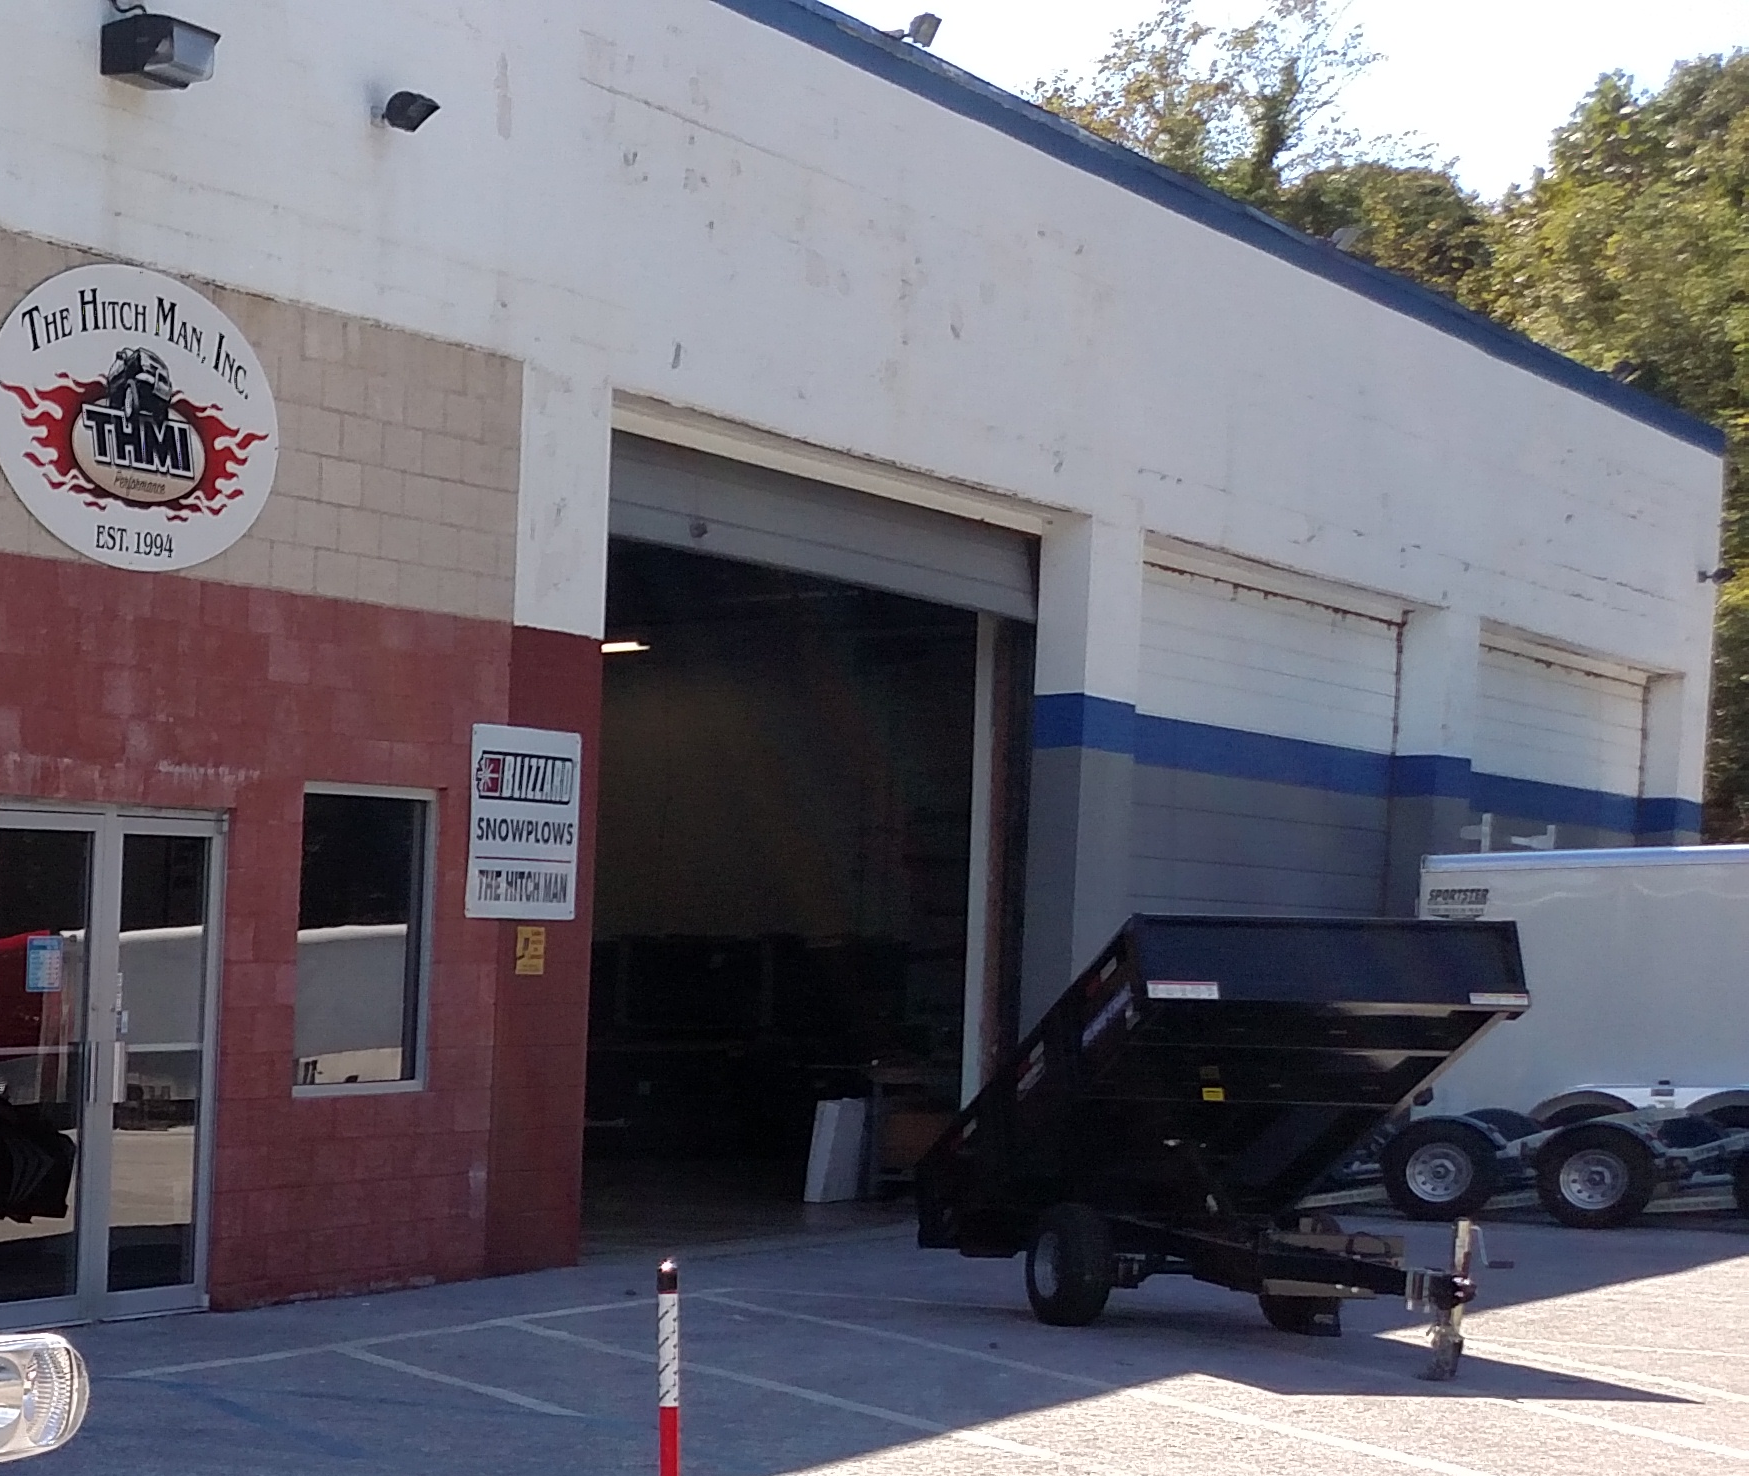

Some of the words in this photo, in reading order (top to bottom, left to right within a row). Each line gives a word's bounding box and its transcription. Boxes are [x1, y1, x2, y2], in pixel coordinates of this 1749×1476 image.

[83, 403, 194, 480] THMI
[114, 469, 167, 497] Performance
[95, 525, 130, 552] EST.
[134, 531, 174, 558] 1994
[502, 755, 574, 802] BLIZZARD
[476, 817, 574, 846] SNOWPLOWS
[477, 869, 502, 902] THE
[505, 871, 539, 903] HITCH
[542, 872, 567, 904] MAN
[1428, 888, 1490, 901] SPORTSTER
